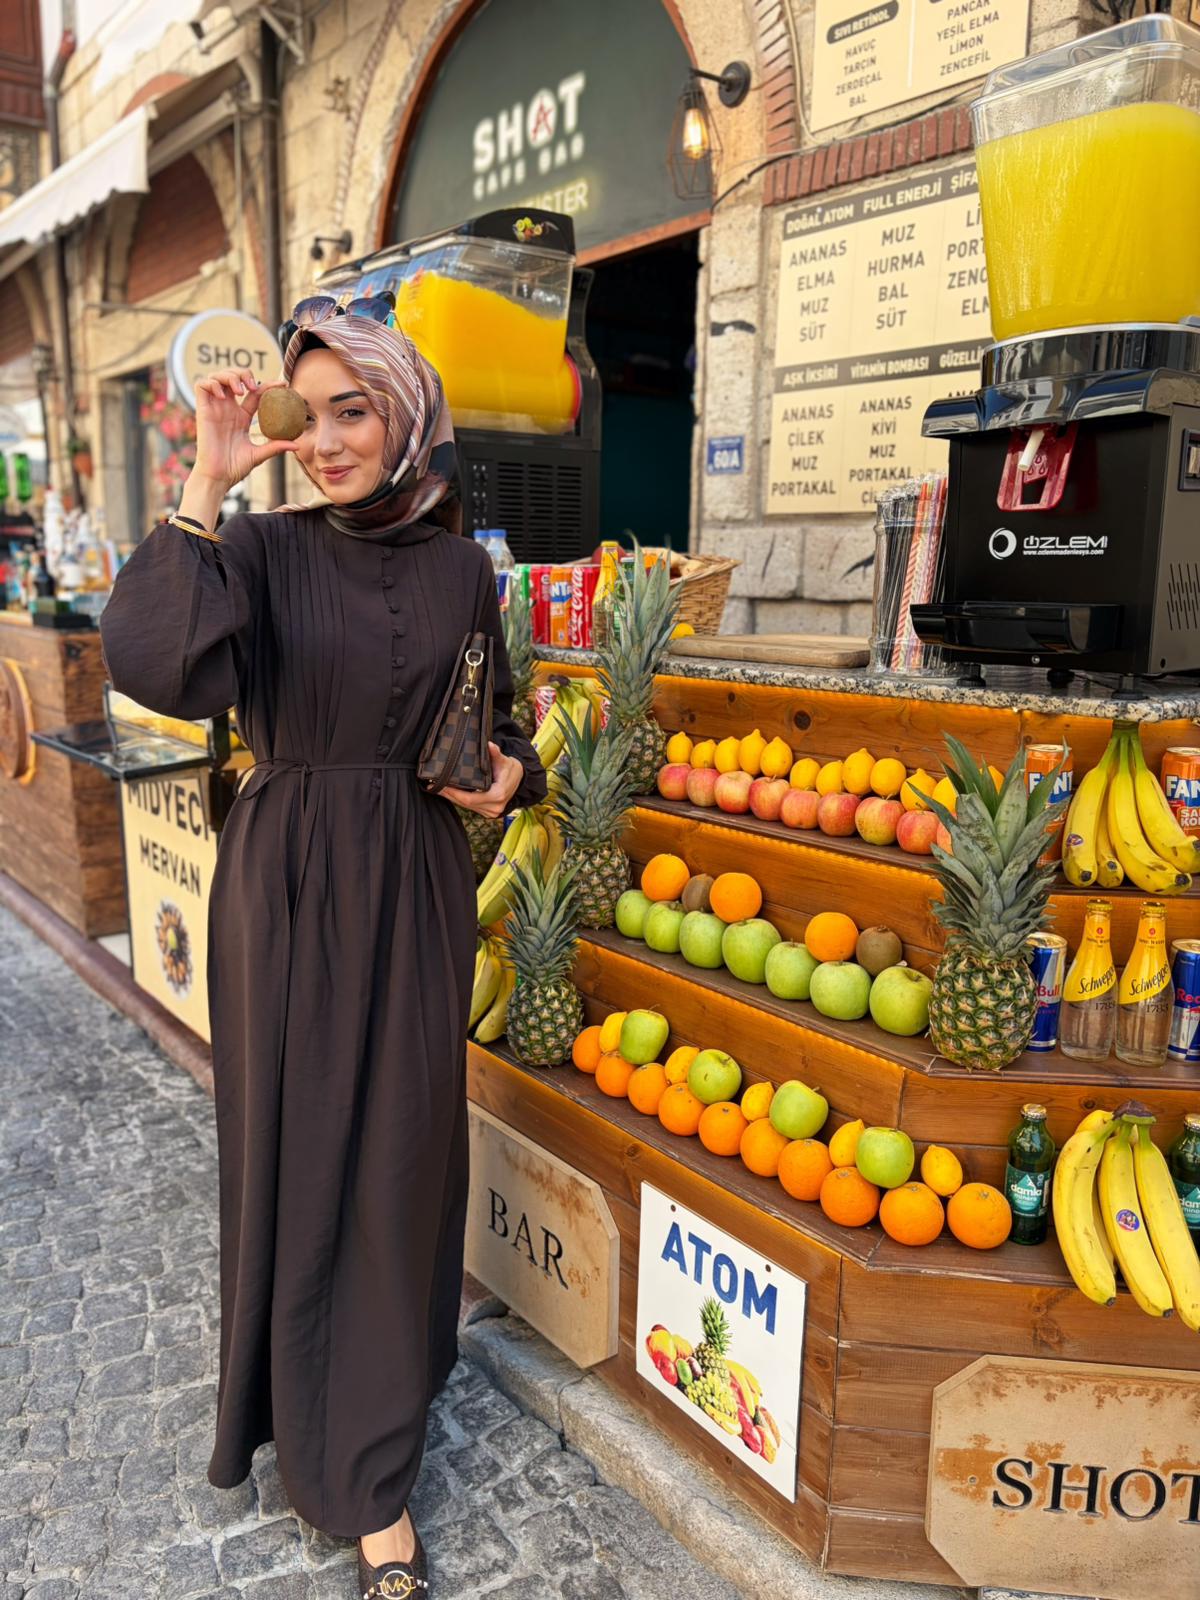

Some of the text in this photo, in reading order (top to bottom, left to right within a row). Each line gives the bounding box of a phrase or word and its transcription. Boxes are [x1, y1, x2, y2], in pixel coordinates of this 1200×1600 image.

[937, 11, 1000, 42] YEŞİL ELMA
[845, 38, 877, 59] HAVUÇ
[949, 34, 984, 56] LİMON
[843, 56, 877, 76] TARÇIN
[940, 50, 991, 77] ZENCEFİL
[835, 72, 883, 96] ZERDEÇAL
[849, 94, 867, 107] BAL
[863, 178, 942, 214] FULL ENERJİ
[786, 204, 854, 234] DOĞAL ATOM
[881, 223, 916, 246] MUZ
[789, 240, 848, 268] ANANAS
[867, 250, 925, 277] HURMA
[797, 270, 835, 292] ELMA
[878, 282, 909, 303] BAL
[800, 298, 829, 317] MUZ
[876, 307, 907, 330] SÜT
[799, 321, 826, 343] SÜT
[197, 343, 267, 371] SHOT
[851, 356, 929, 379] VİTAMİN BOMBASI
[783, 366, 838, 389] AŞK İKSİRİ
[782, 404, 834, 424] ANANAS
[859, 396, 912, 414] ANANAS
[871, 418, 897, 436] KİVİ
[787, 430, 825, 448] ÇİLEK
[869, 444, 896, 459] MUZ
[792, 456, 818, 471] MUZ
[849, 466, 914, 483] PORTAKAL
[771, 480, 836, 496] PORTAKAL
[139, 834, 201, 898] MERVAN
[487, 1187, 569, 1290] BAR
[661, 1221, 778, 1335] ATOM
[992, 1458, 1200, 1525] SHOT
